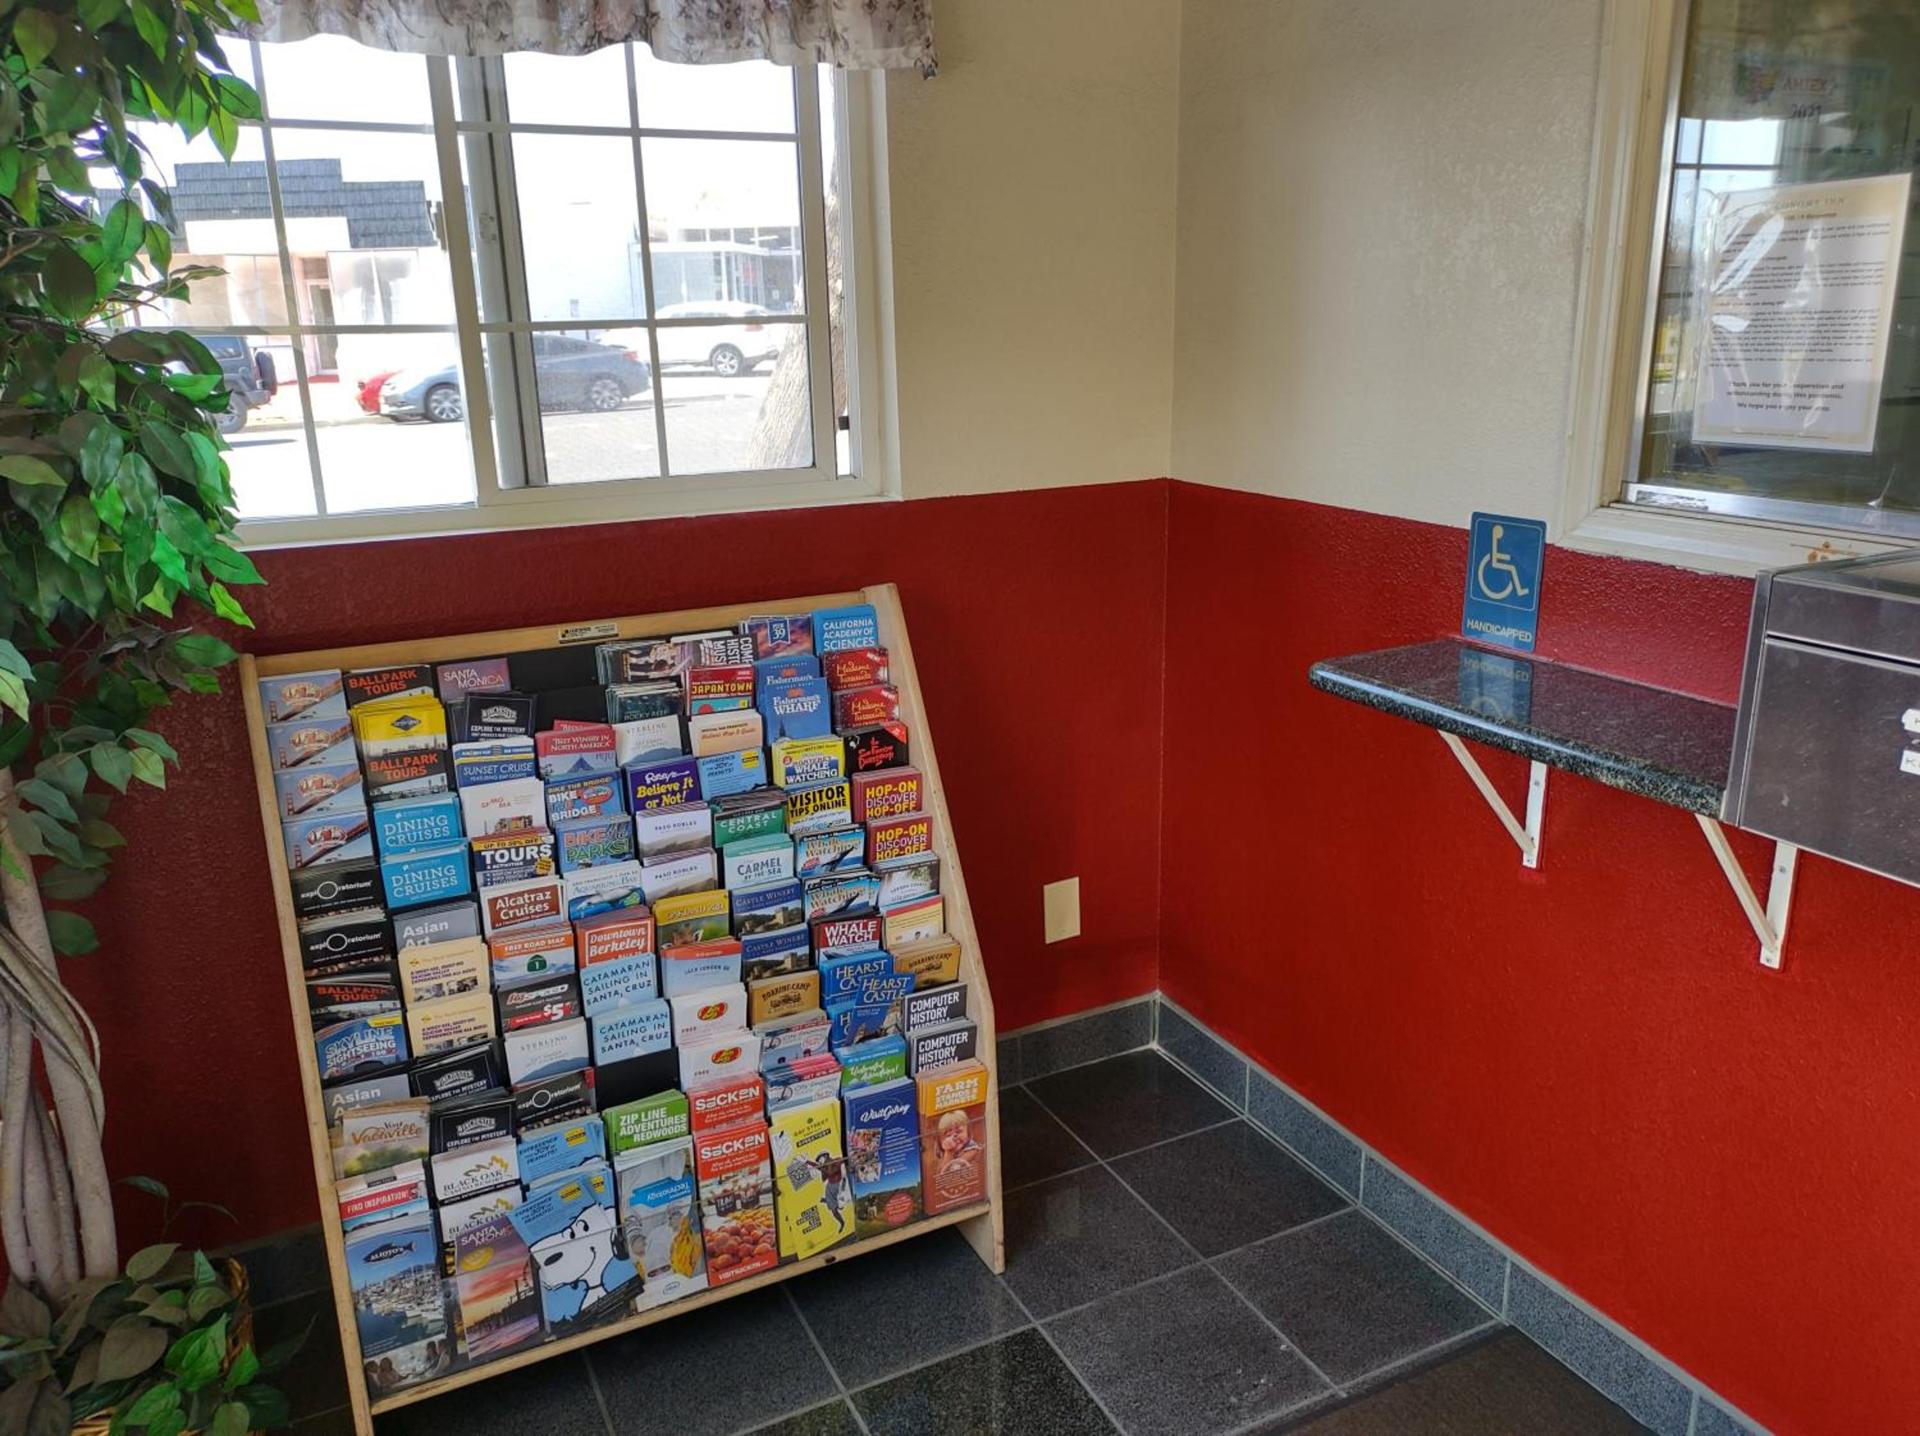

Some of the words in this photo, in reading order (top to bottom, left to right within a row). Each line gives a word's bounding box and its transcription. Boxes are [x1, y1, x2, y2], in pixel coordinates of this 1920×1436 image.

[823, 618, 873, 631] CALIFORNIA
[1466, 618, 1532, 642] HANDICAPPED
[774, 628, 786, 640] 39
[823, 629, 862, 639] ACADEMY
[823, 637, 875, 651] SCIENCES
[349, 670, 416, 688] BALLPARK
[443, 668, 478, 681] SANTA
[458, 674, 504, 688] MONICA
[364, 680, 407, 695] TOURS
[692, 682, 752, 694] JAPANTOWN
[773, 694, 821, 706] Fisherman's
[774, 702, 819, 715] WHARF
[370, 752, 438, 772] BALLPARK
[463, 764, 497, 776] SUNSET
[500, 762, 532, 772] CRUISE
[794, 762, 829, 773] WHALE
[385, 765, 428, 780] TOURS
[785, 769, 838, 784] WATCHING
[549, 790, 578, 803] BIKE
[637, 781, 679, 798] Believe
[682, 777, 694, 789] It
[866, 780, 917, 798] HOP-ON
[645, 799, 659, 808] or
[661, 790, 687, 807] Not!
[789, 786, 846, 808] VISITOR
[866, 792, 917, 808] DISCOVER
[551, 807, 597, 822] BRIDGE
[790, 805, 809, 818] TIPS
[814, 799, 847, 811] ONLINE
[866, 802, 916, 818] HOP-OFF
[384, 815, 448, 836] DINING
[720, 813, 777, 828] CENTRAL
[729, 821, 768, 833] COAST
[385, 827, 450, 847] CRUISES
[565, 828, 606, 847] BIKE
[876, 823, 928, 842] HOP-ON
[876, 834, 928, 852] DISCOVER
[876, 843, 927, 861] HOP-OFF
[481, 844, 552, 865] TOURS
[392, 864, 456, 887] DINING
[737, 858, 782, 876] CARMEL
[768, 867, 782, 875] SEA
[393, 876, 458, 898] CRUISES
[496, 890, 551, 910] Alcatraz
[736, 894, 763, 906] CASTLE
[766, 888, 795, 899] WINERY
[500, 902, 549, 920] Cruises
[402, 920, 449, 938] Asian
[590, 927, 646, 944] Downtown
[825, 921, 878, 936] WHALE
[405, 938, 430, 949] Art
[524, 940, 546, 948] ROAD
[590, 938, 646, 957] Berkeley
[746, 941, 774, 952] CASTLE
[776, 935, 804, 945] WINERY
[827, 931, 873, 947] WATCH
[583, 960, 650, 987] CATAMARAN
[836, 959, 888, 980] HEARST
[586, 989, 623, 1006] SANTA,
[625, 979, 652, 994] CRUZ
[588, 977, 630, 996] SAILING
[635, 971, 648, 980] IN
[862, 977, 911, 991] HEARST
[333, 993, 378, 1001] TOURS
[864, 990, 905, 1003] CASTLE
[910, 992, 960, 1012] COMPUTER
[600, 1012, 668, 1035] CATAMARAN
[910, 1007, 948, 1023] HISTORY
[603, 1026, 648, 1042] SAILING
[654, 1022, 665, 1030] IN
[601, 1039, 640, 1054] SANTA,
[641, 1032, 669, 1042] CRUZ
[918, 1031, 969, 1052] COMPUTER
[326, 1041, 396, 1069] SIGHTSEEING
[918, 1046, 957, 1066] HISTORY
[935, 1077, 978, 1096] FARM
[332, 1088, 381, 1106] Asian
[619, 1114, 687, 1136] ADVENTURES
[620, 1113, 640, 1126] ZIP
[641, 1107, 667, 1121] LINE
[633, 1124, 687, 1142] REDWOODS
[443, 1175, 478, 1191] BLACK
[480, 1170, 502, 1182] OAK
[461, 1225, 497, 1246] SANTA
